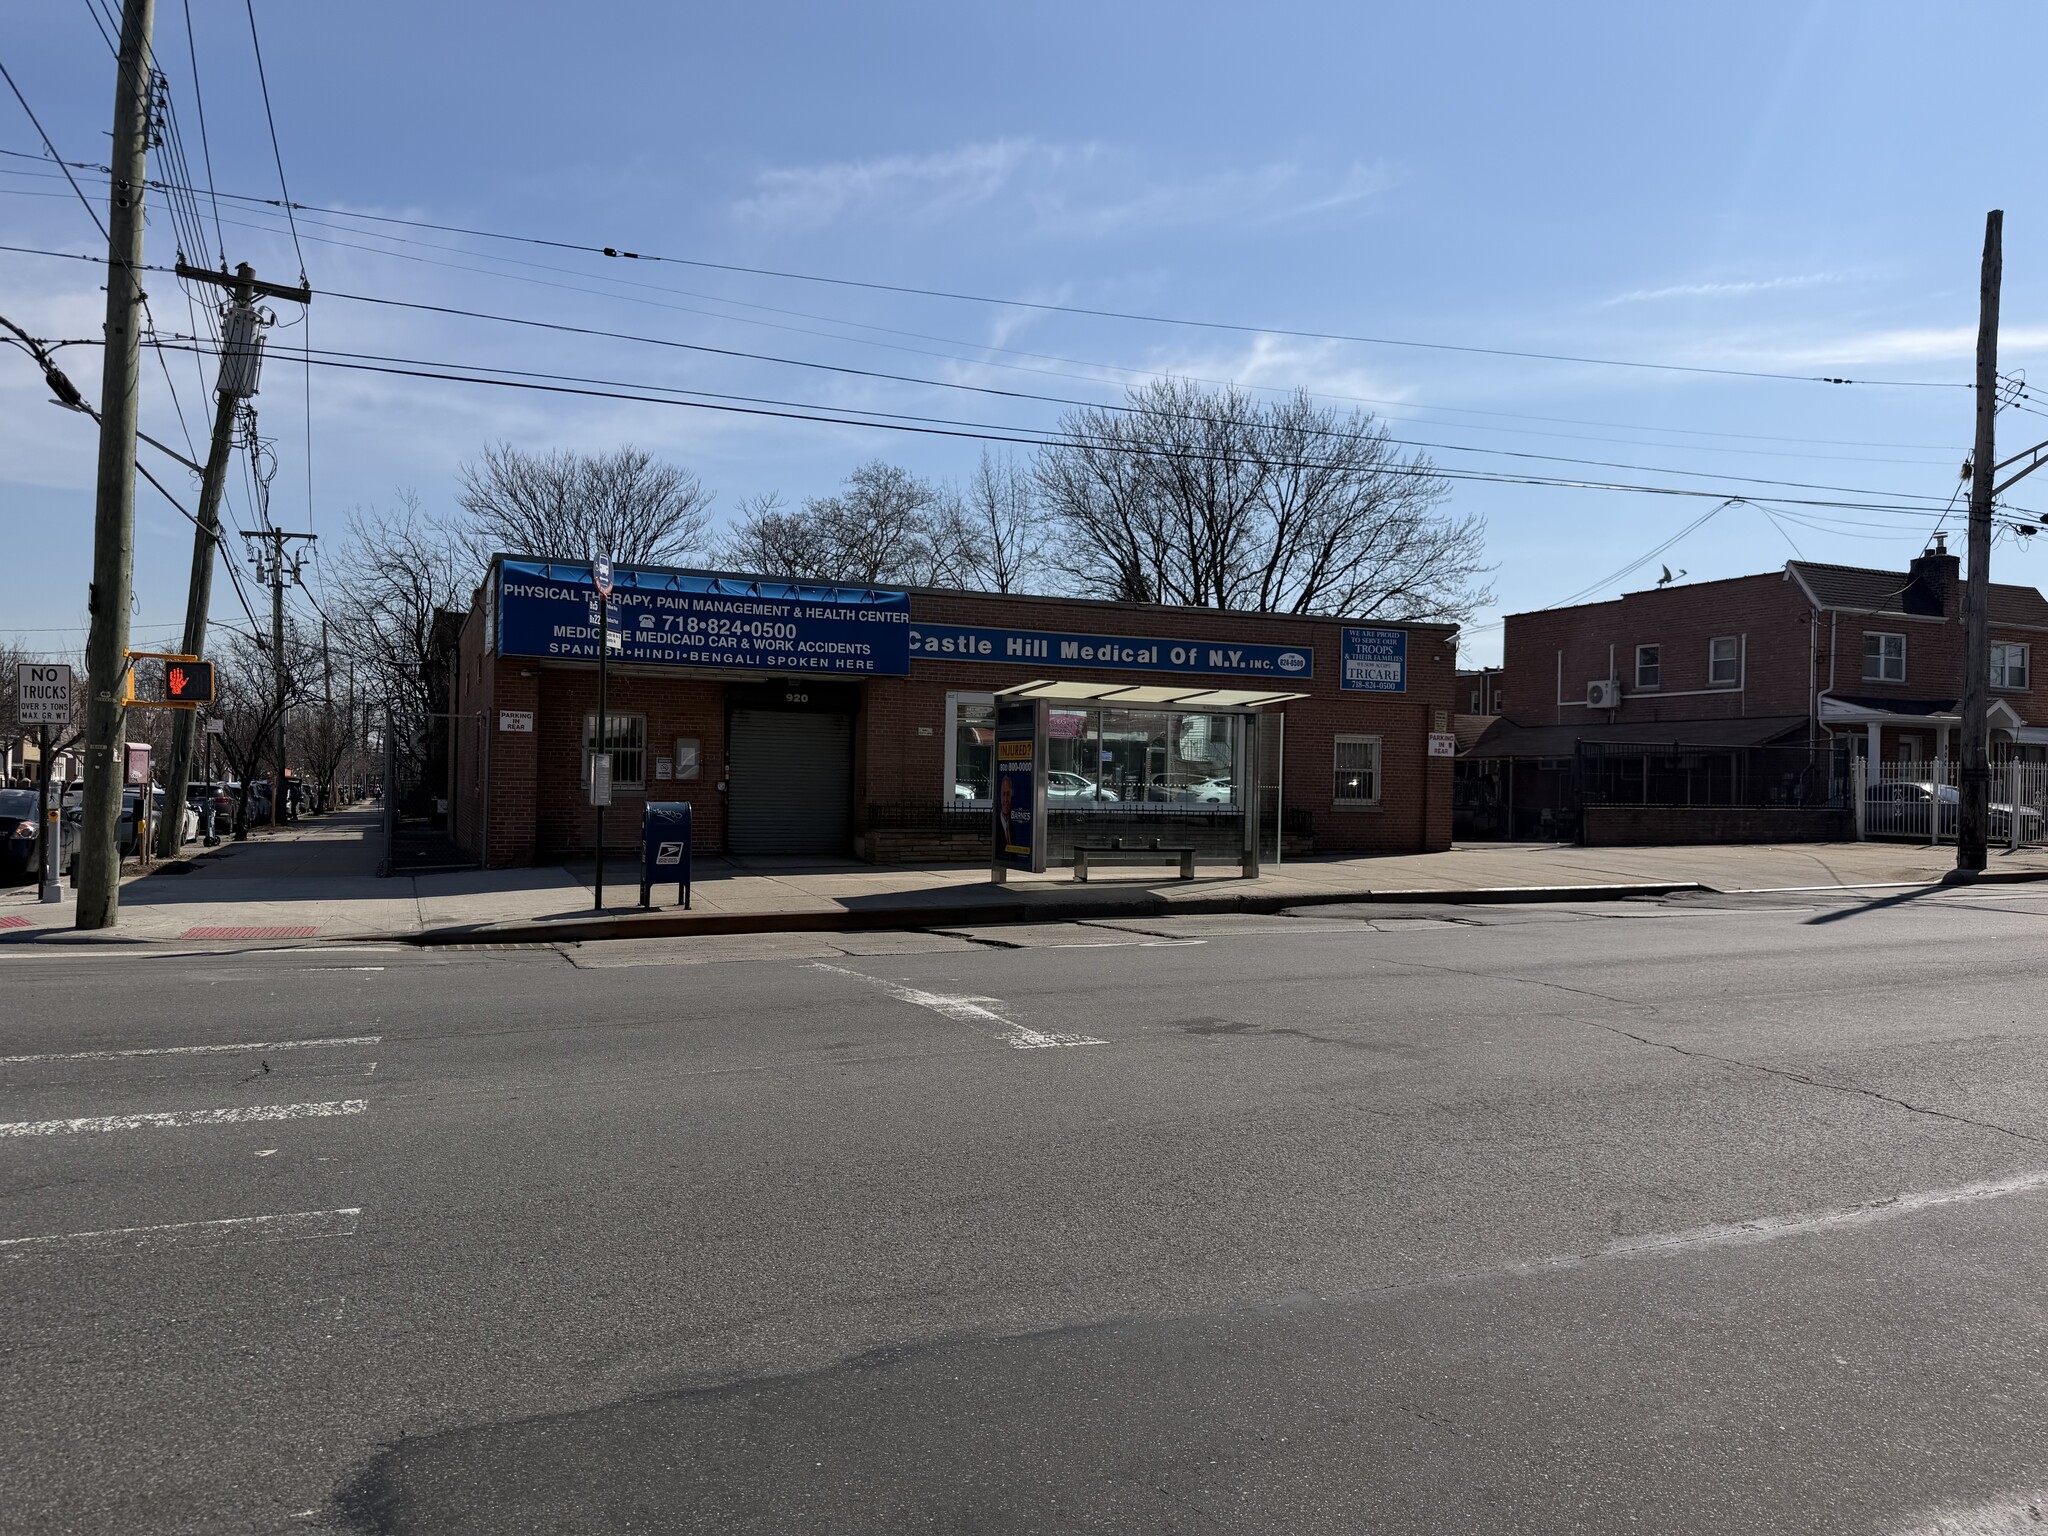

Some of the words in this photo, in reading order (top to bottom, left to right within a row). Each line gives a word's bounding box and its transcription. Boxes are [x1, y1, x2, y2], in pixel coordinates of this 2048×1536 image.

[503, 584, 580, 601] PHYSICAL
[657, 597, 689, 610] PAIN
[692, 599, 791, 617] MANAGEMENT
[793, 607, 802, 618] &
[805, 608, 856, 621] HEALTH
[858, 610, 910, 624] CENTER
[553, 625, 632, 642] MEDICE
[635, 631, 704, 646] MEDICAID
[708, 635, 738, 649] CAR
[740, 638, 750, 649] &
[753, 638, 795, 652] WORK
[797, 641, 871, 655] ACCIDENTS
[1376, 631, 1400, 639] PROUD
[909, 630, 993, 655] Castle
[1006, 637, 1048, 658] Hill
[1060, 641, 1158, 664] Medical
[1169, 646, 1198, 665] Of
[1208, 649, 1246, 669] N.Y.
[1249, 659, 1274, 670] INC.
[1354, 643, 1394, 655] TROOPS
[767, 655, 829, 668] SPOKEN
[835, 659, 875, 670] HERE
[1279, 658, 1304, 667] 824-0500
[1351, 653, 1373, 661] THEIR
[1373, 654, 1403, 662] FAMILIES
[32, 668, 57, 681] NO
[1347, 668, 1400, 681] TRICARE
[1351, 680, 1396, 690] 718-824-0500
[23, 685, 66, 699] TRUCKS
[785, 693, 809, 703] 920
[1000, 743, 1032, 757] INJURED?
[1008, 762, 1032, 772] 800-0000
[1010, 810, 1031, 821] BARNES
